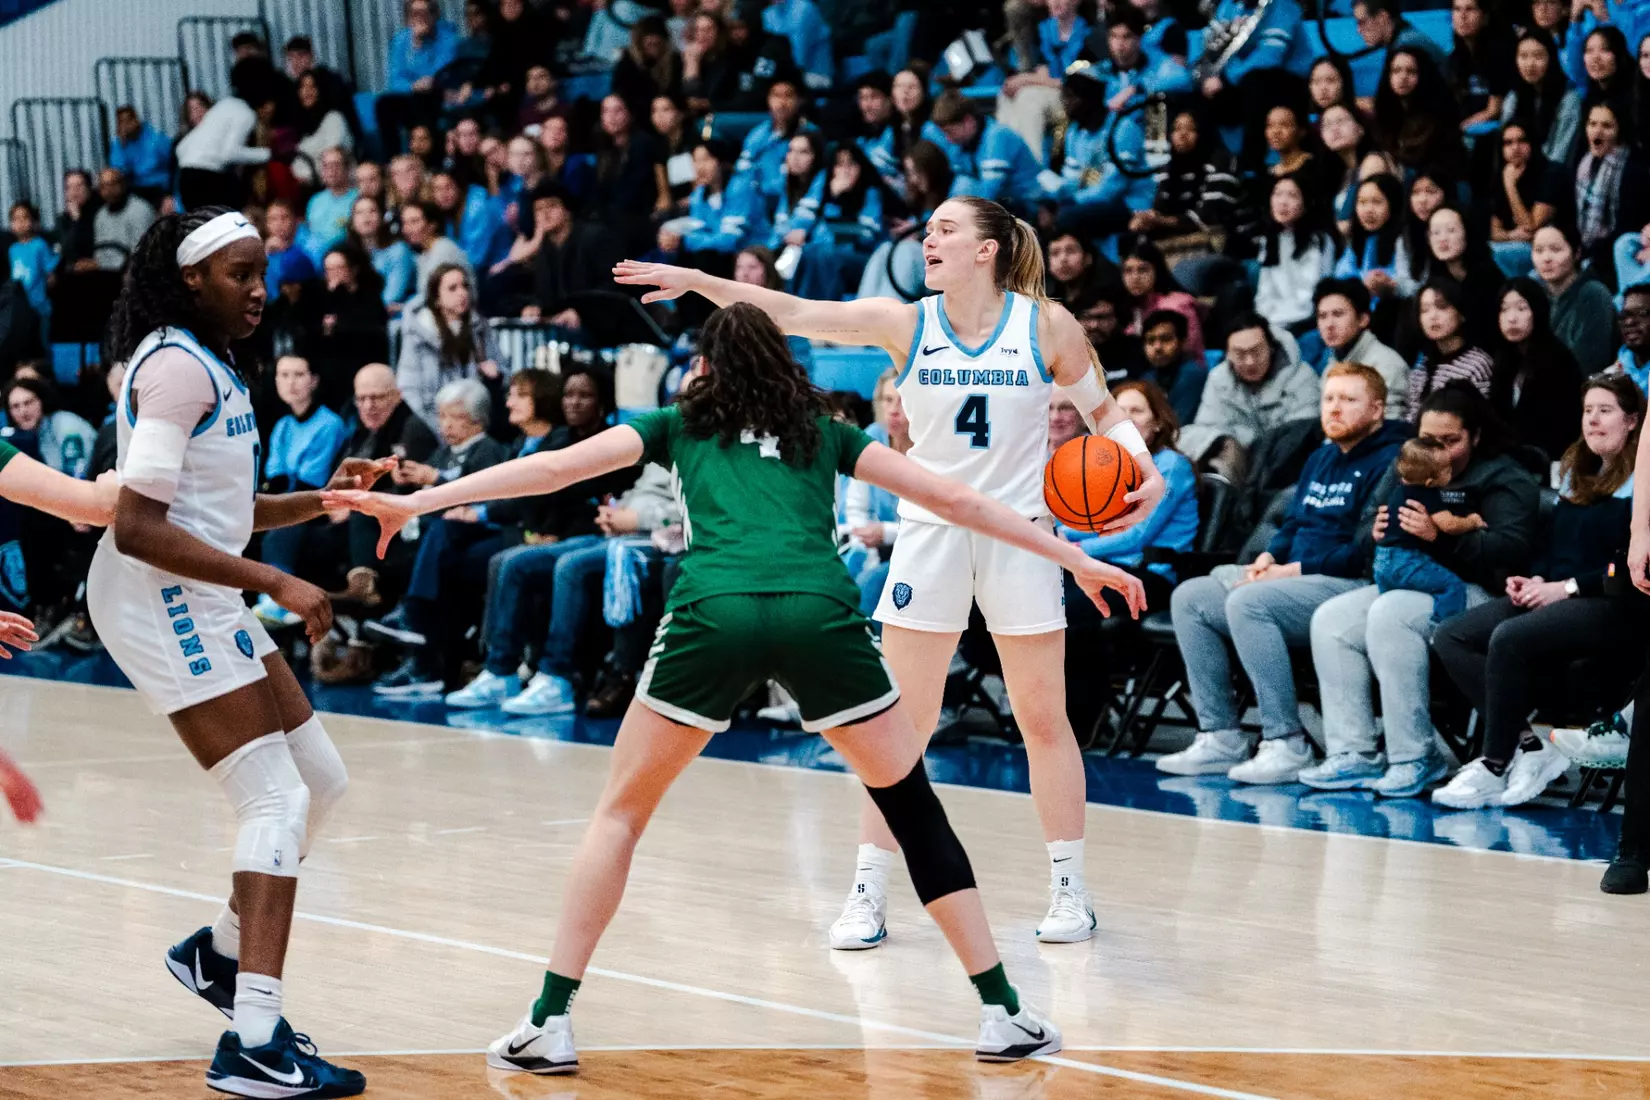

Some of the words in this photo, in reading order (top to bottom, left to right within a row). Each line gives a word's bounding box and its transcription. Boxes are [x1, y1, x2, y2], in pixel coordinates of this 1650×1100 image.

[918, 368, 1029, 386] COLUMBIA
[954, 393, 991, 450] 4
[161, 584, 212, 676] LIONS
